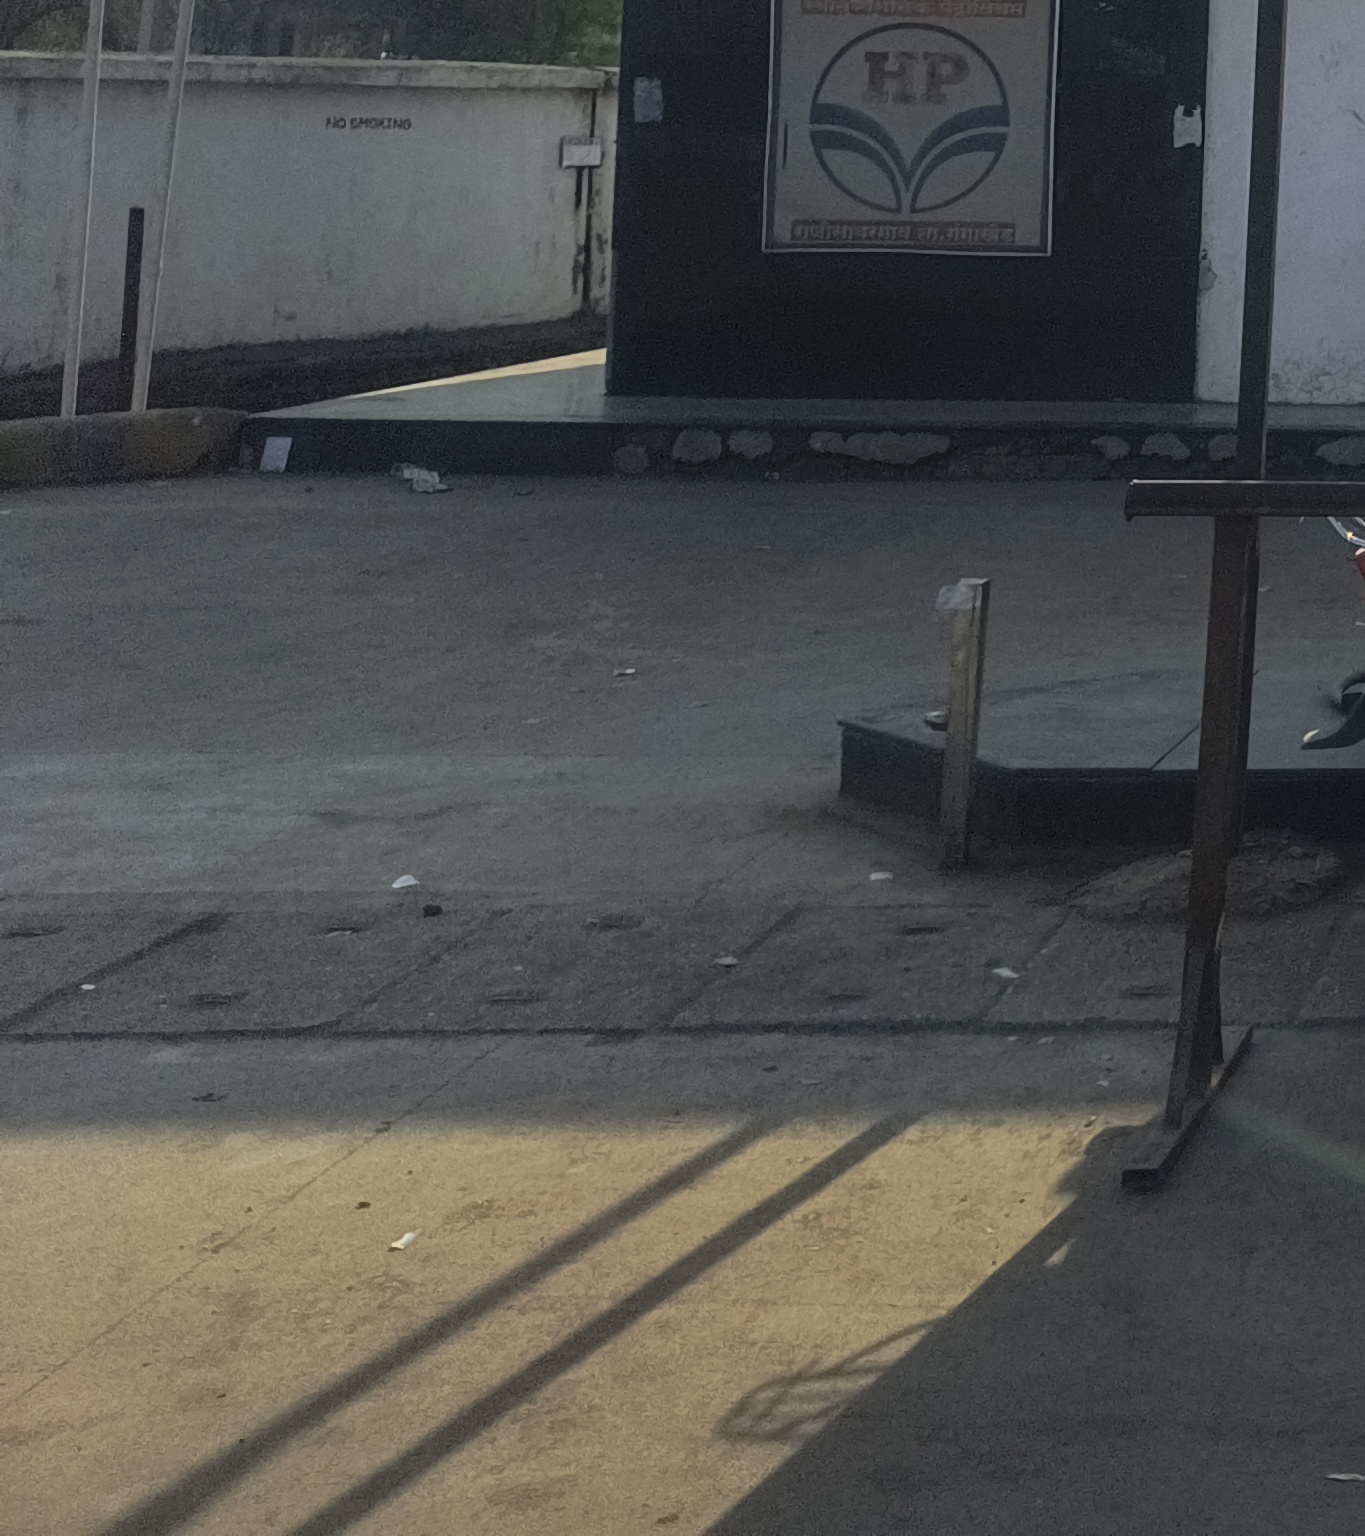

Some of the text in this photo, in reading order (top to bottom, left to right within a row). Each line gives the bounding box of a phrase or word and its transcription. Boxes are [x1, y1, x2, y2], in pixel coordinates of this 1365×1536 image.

[864, 51, 970, 105] HP
[325, 116, 412, 130] NO SMOKING
